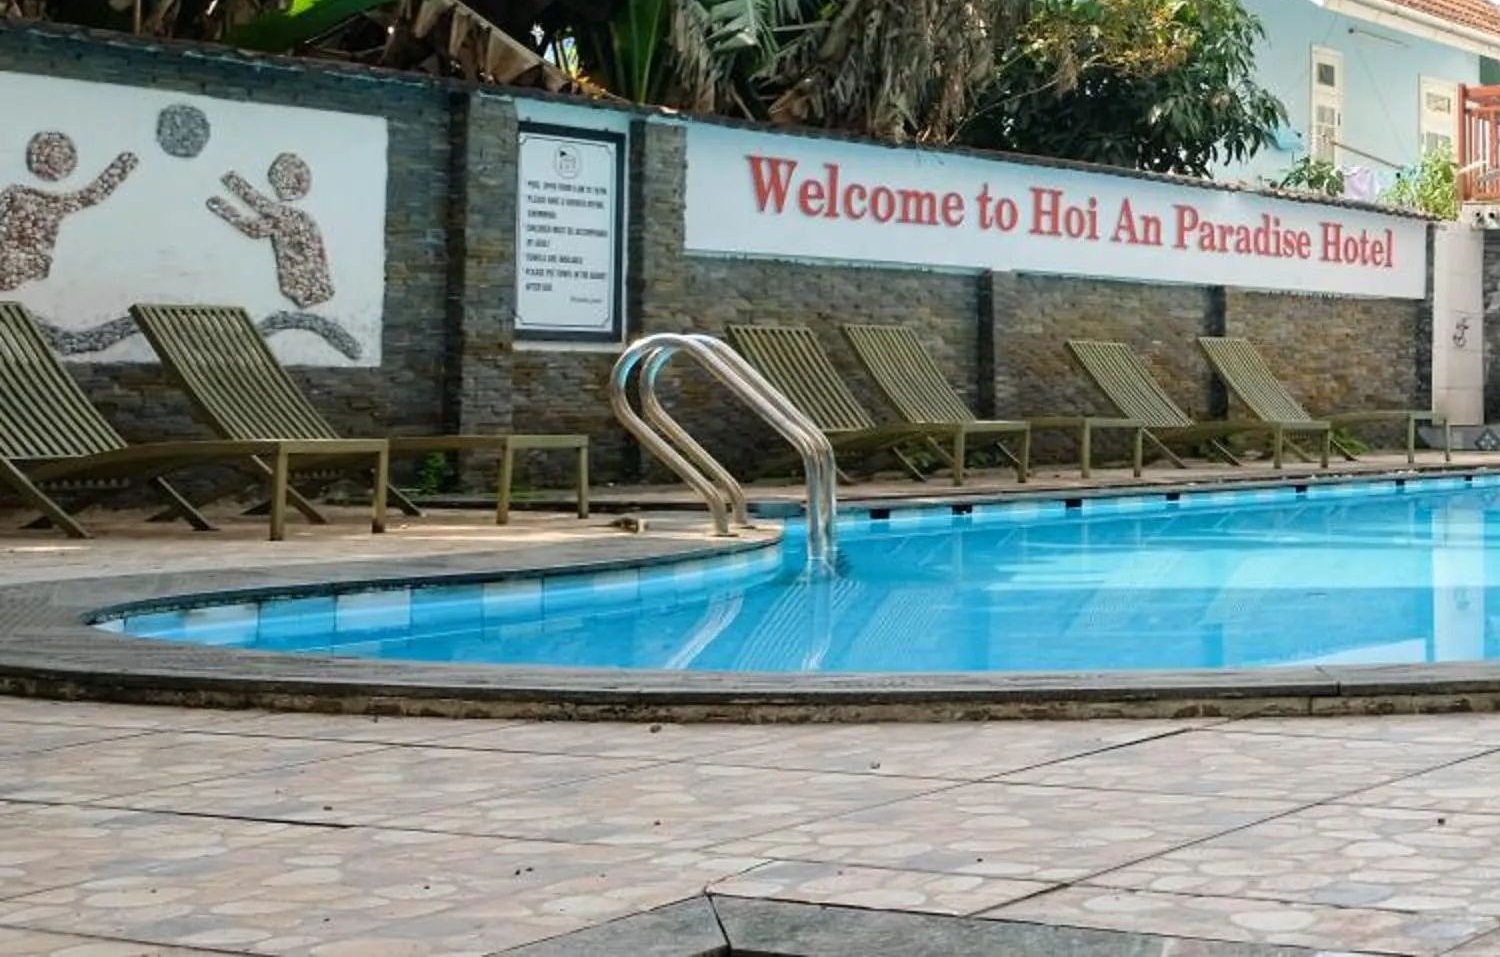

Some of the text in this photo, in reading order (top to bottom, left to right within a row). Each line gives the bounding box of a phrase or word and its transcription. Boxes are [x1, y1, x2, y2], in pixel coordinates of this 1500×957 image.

[746, 155, 1394, 268] Welcome to Hoi An Paradise Hotel
